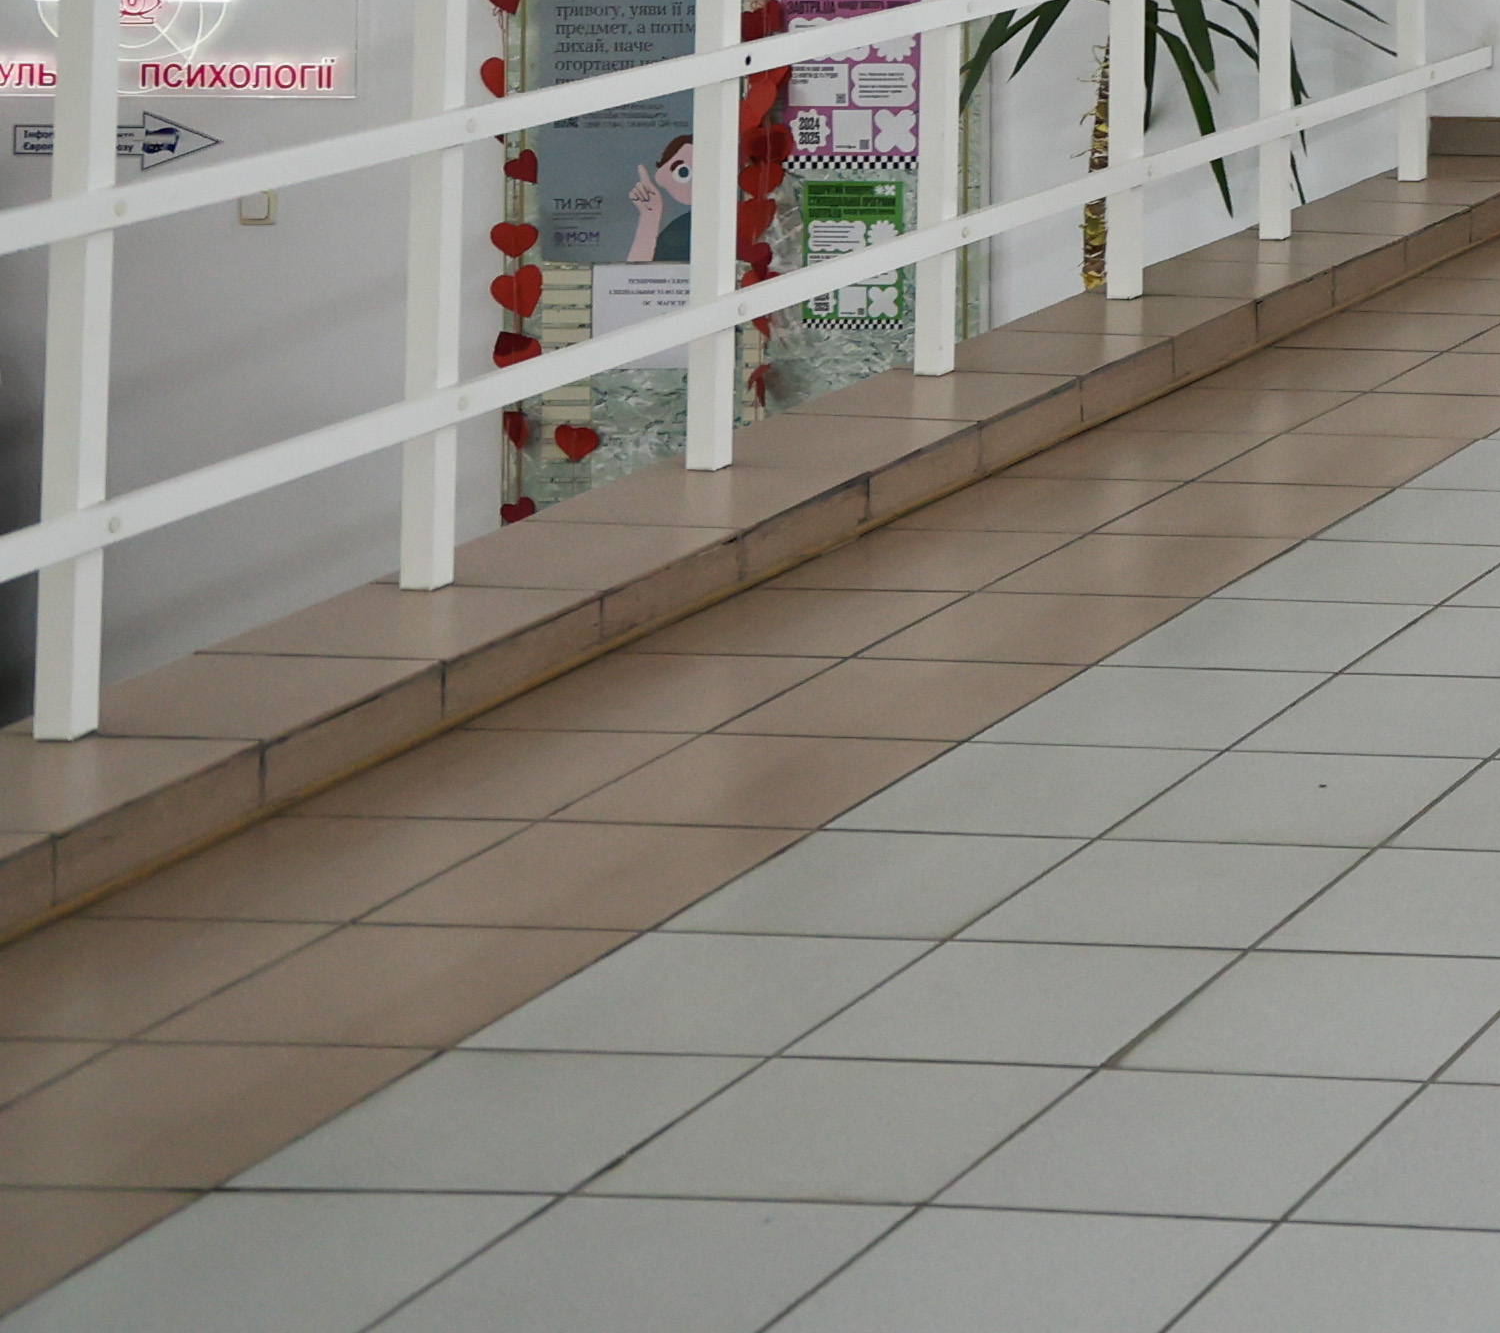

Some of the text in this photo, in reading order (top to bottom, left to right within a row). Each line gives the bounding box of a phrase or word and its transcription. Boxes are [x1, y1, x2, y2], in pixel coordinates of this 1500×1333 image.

[556, 5, 624, 20] тривогу,
[629, 5, 667, 20] уяви
[555, 23, 632, 39] предмет,
[636, 24, 646, 34] а
[554, 39, 653, 54] дихай, наче
[140, 56, 335, 89] ПСИХОЛОГІЇ
[798, 116, 821, 131] 2024
[798, 131, 821, 145] 2025
